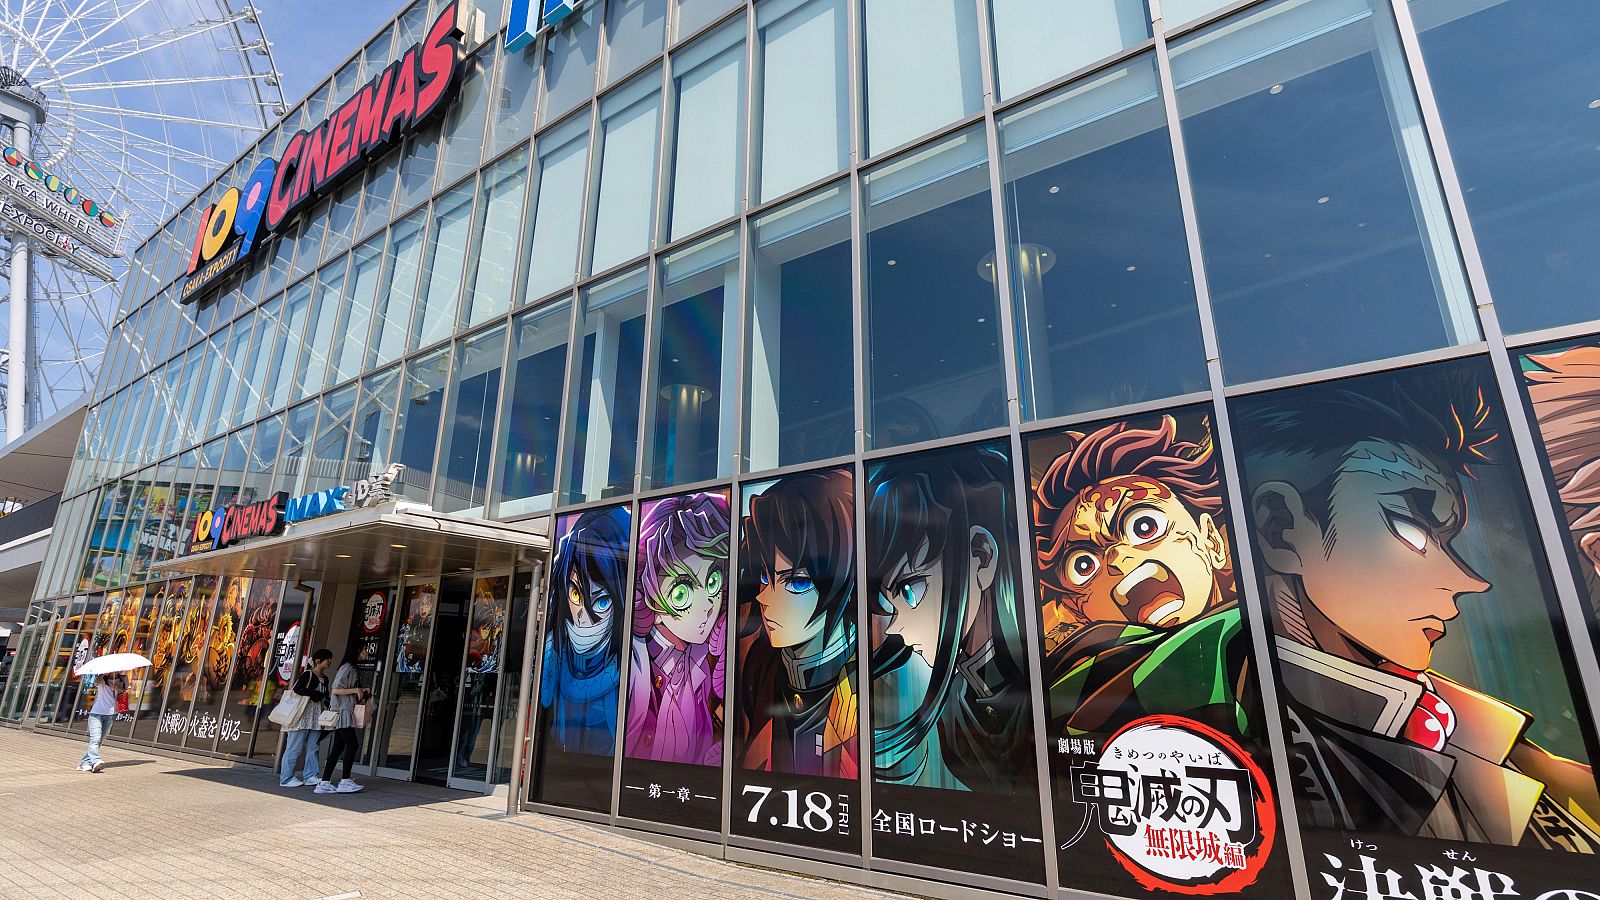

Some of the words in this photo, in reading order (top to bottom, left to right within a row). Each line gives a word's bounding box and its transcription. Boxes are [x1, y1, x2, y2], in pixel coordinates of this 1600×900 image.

[187, 157, 274, 275] 109
[267, 2, 457, 228] CINEMAS
[45, 197, 95, 237] WHEEL
[192, 507, 225, 549] 109
[221, 494, 279, 546] CINEMAS
[1057, 737, 1096, 756] 劇場版
[1113, 746, 1223, 766] きめつのやいば
[648, 782, 690, 803] 第一章
[741, 784, 834, 832] 7.18
[1061, 758, 1256, 850] 鬼滅の刃
[871, 808, 1042, 849] 全国ロードショー
[1144, 823, 1245, 868] 無限城編
[1350, 838, 1378, 851] けっ
[1442, 849, 1477, 862] せん
